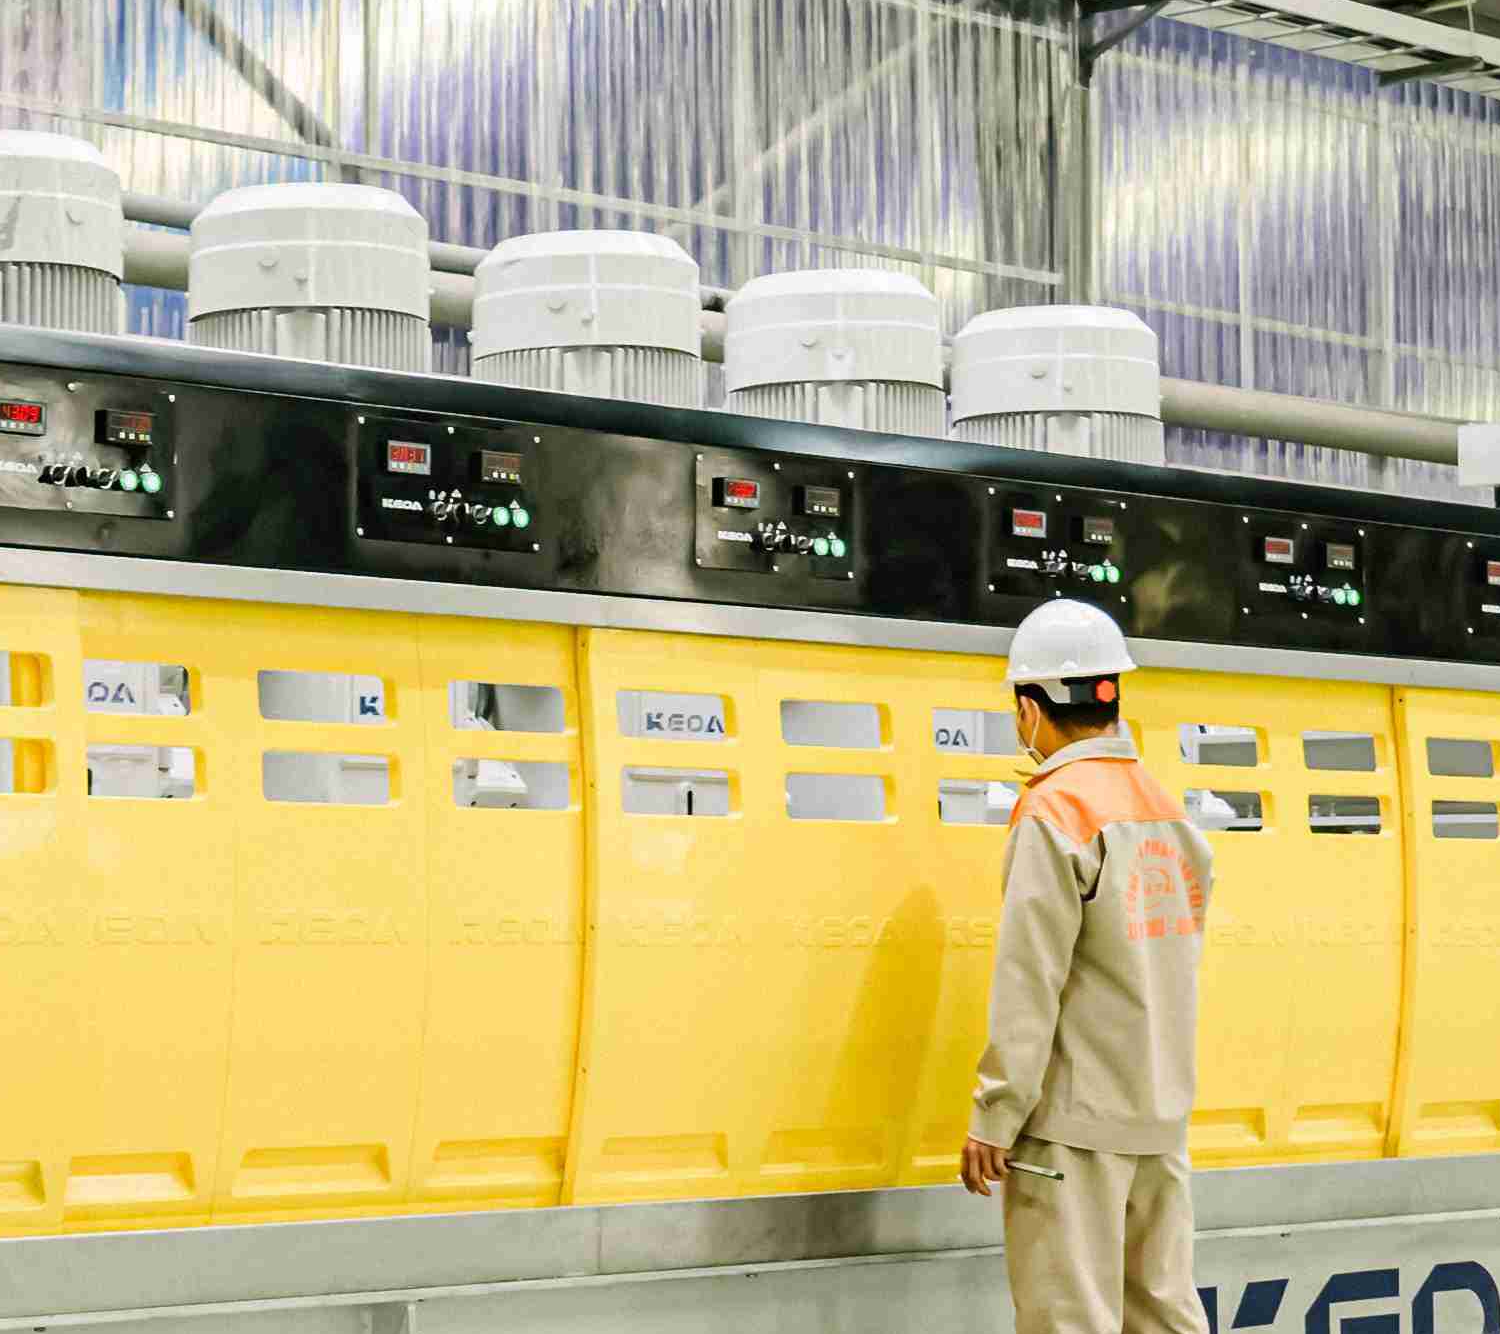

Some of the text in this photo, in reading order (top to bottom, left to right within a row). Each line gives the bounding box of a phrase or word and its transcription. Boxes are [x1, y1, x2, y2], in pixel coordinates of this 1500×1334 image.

[381, 498, 423, 511] KEDA
[717, 530, 753, 543] KEDA
[87, 681, 136, 704] DA
[646, 712, 724, 733] KEDA
[91, 907, 215, 947] EDA
